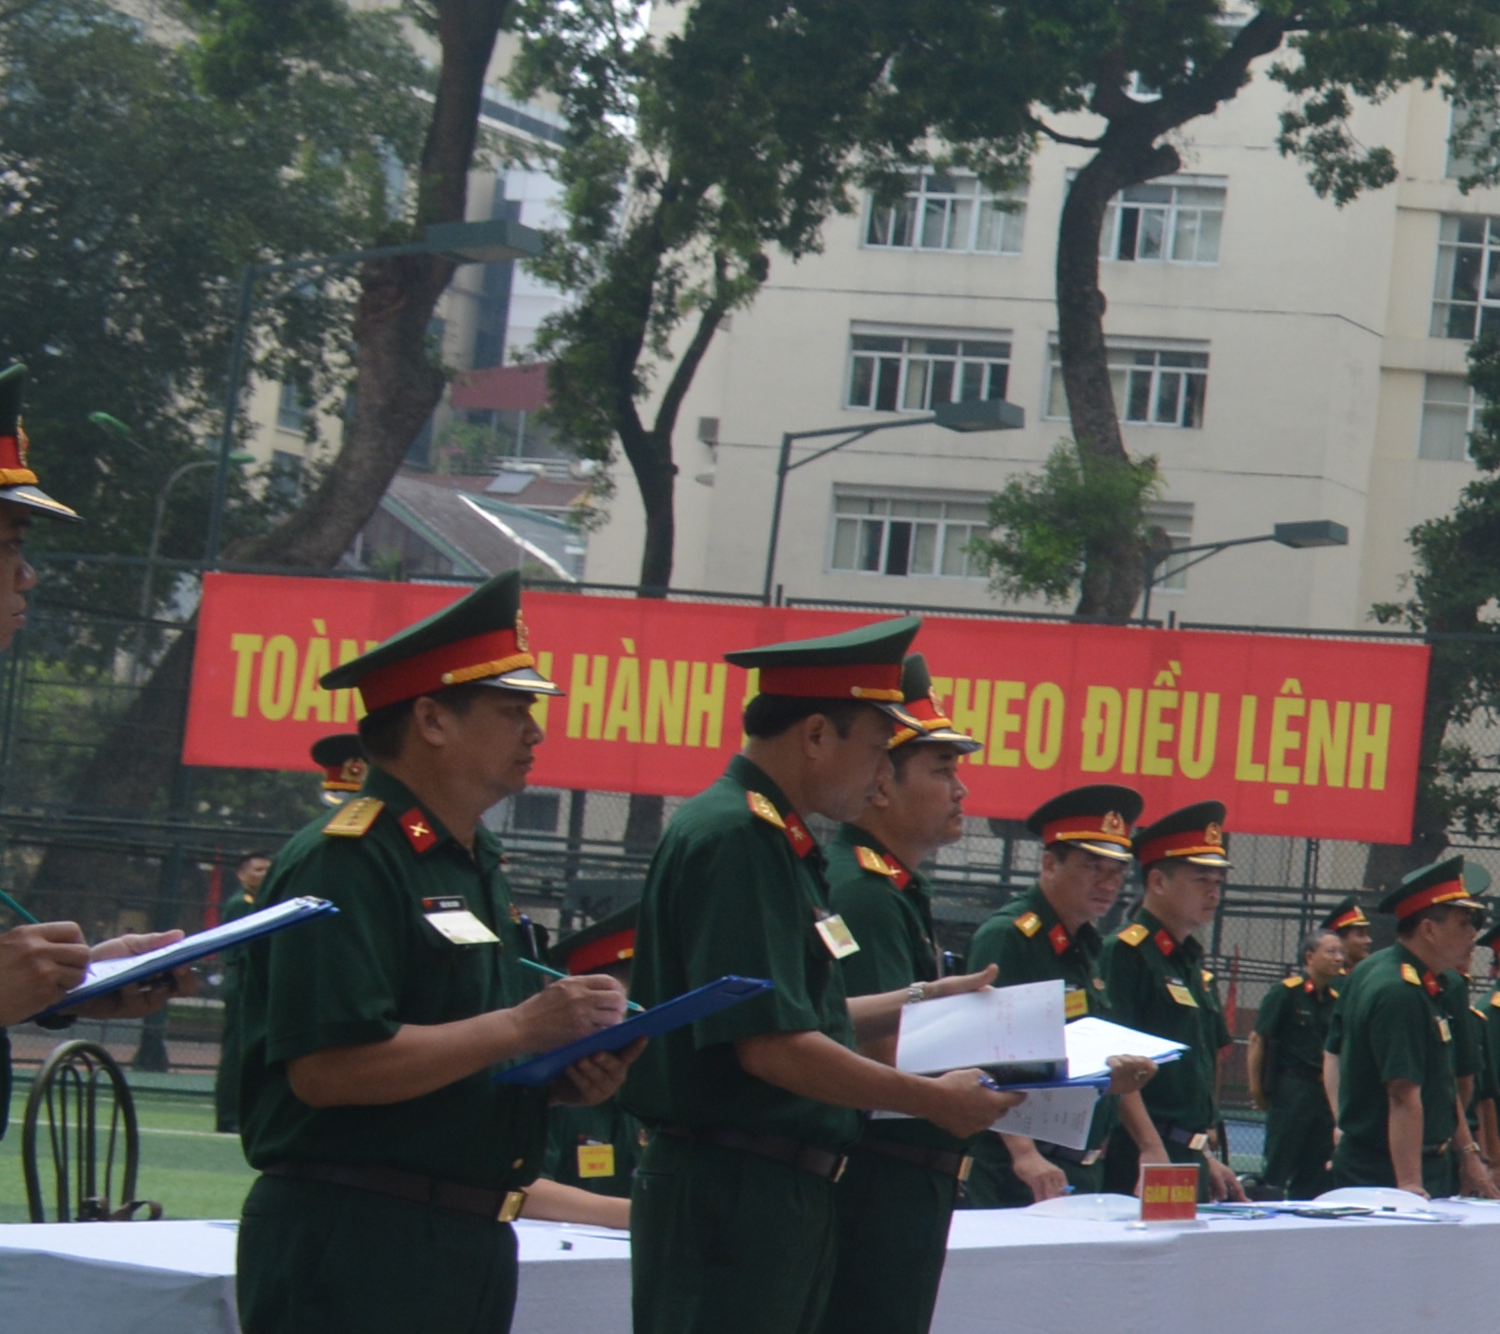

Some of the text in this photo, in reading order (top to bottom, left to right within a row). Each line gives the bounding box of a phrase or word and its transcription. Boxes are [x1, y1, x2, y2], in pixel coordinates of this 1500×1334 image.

[566, 637, 728, 749] HÀNH
[1080, 660, 1219, 780] ĐIỀU
[1235, 677, 1392, 805] LỆNH
